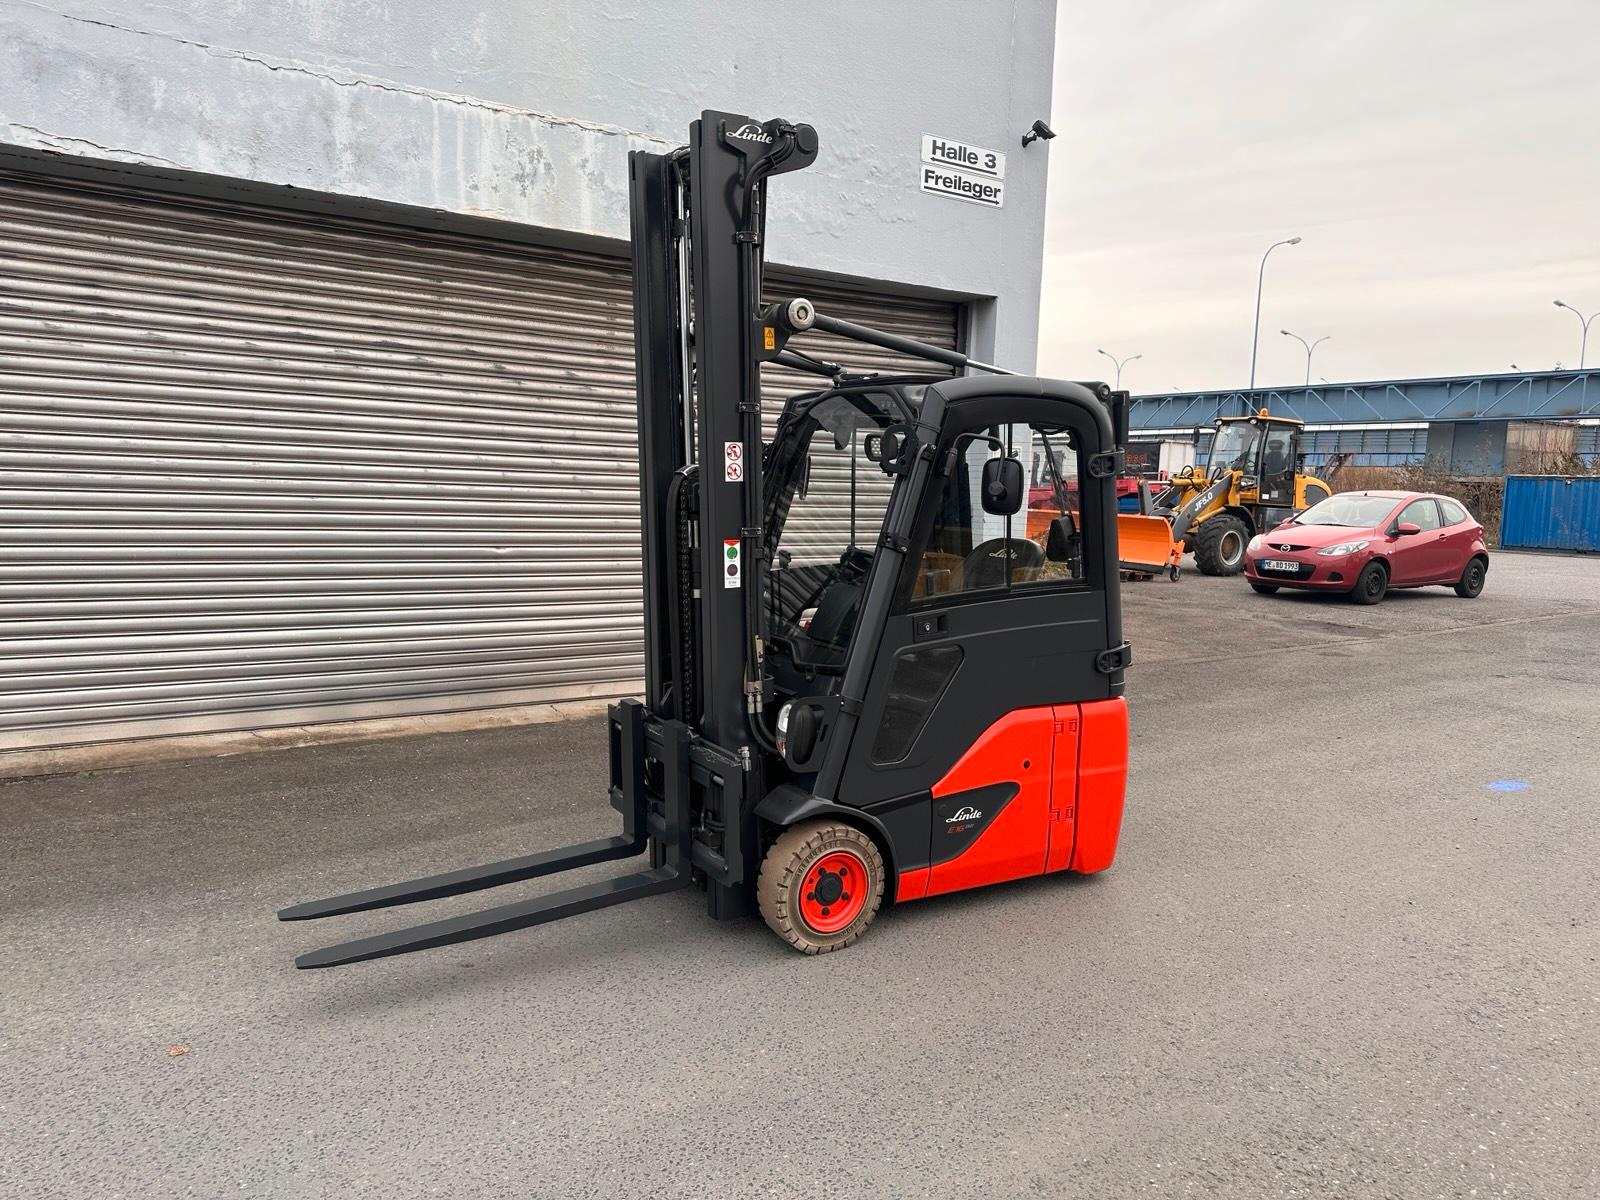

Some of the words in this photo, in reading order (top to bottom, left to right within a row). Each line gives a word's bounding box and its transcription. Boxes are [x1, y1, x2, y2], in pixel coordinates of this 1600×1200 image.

[726, 124, 773, 144] Linde
[932, 140, 978, 165] Halle
[984, 153, 997, 169] 3
[924, 169, 1001, 198] Freilager
[1194, 492, 1213, 511] JF5.0
[946, 806, 982, 823] Linde
